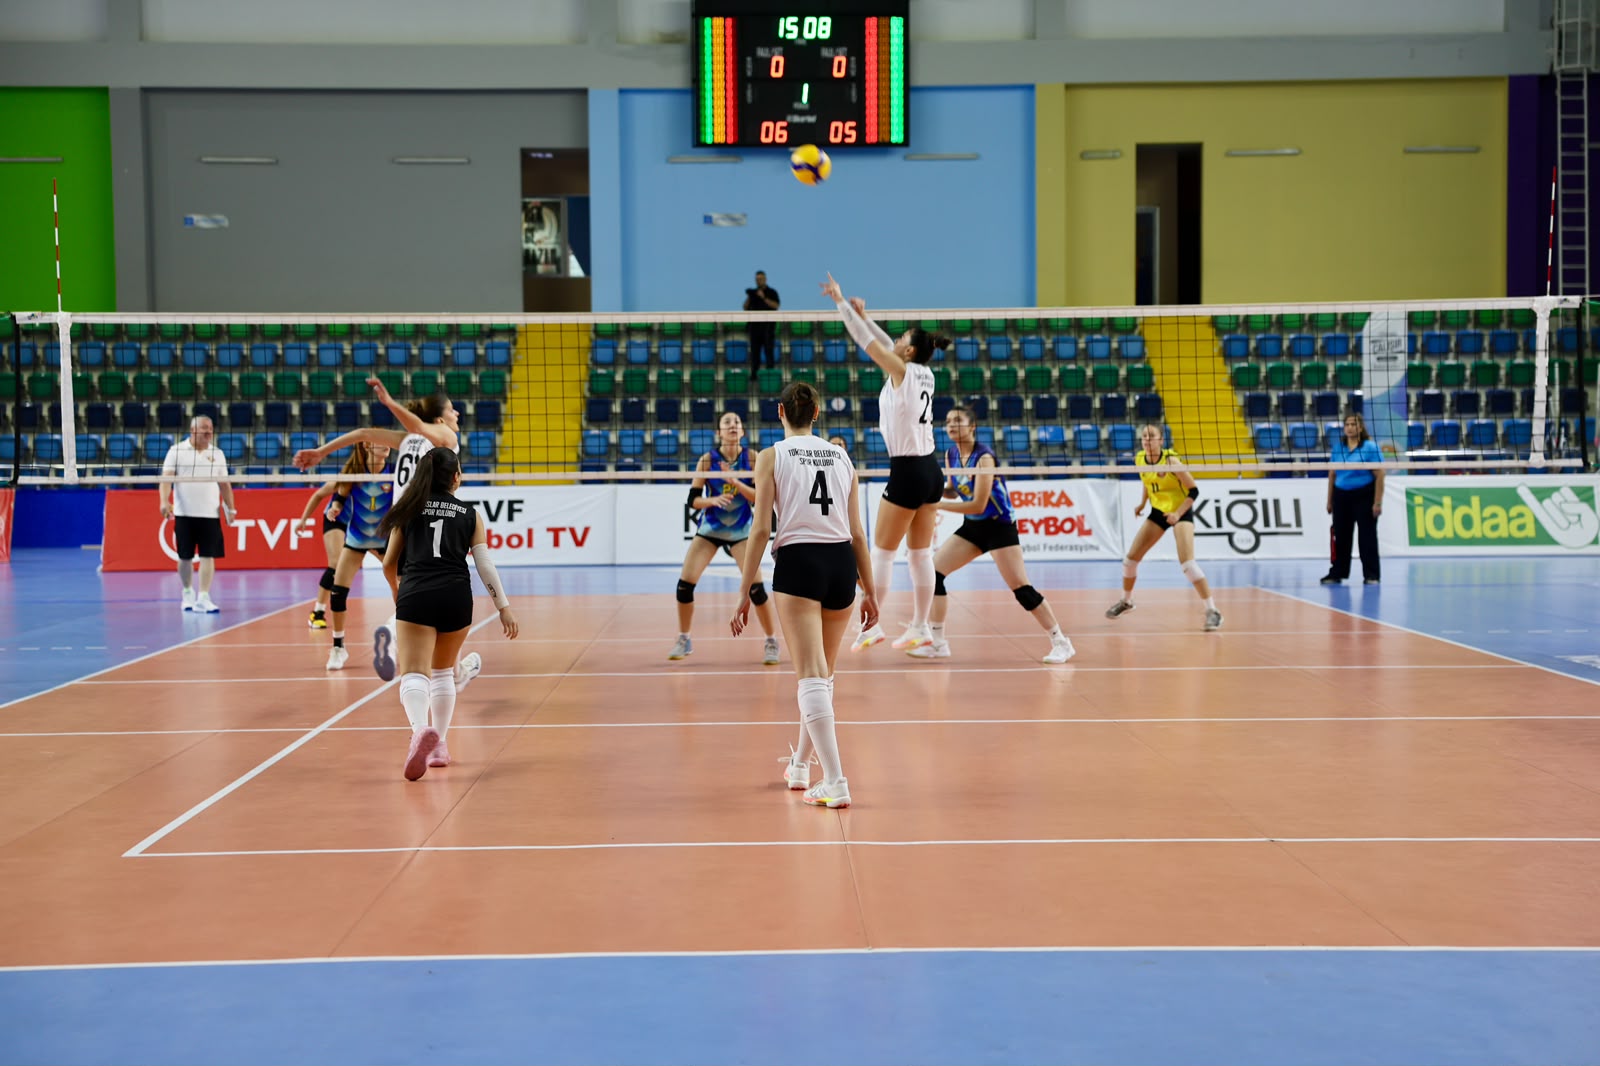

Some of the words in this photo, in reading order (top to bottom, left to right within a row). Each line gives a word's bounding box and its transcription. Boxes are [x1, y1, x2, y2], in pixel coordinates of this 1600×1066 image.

[770, 55, 784, 78] 0
[832, 55, 847, 78] 0
[802, 83, 809, 104] 1
[760, 121, 788, 143] 06
[829, 121, 857, 143] 05
[919, 390, 933, 424] 2
[397, 453, 420, 486] 6
[809, 470, 833, 516] 4
[1151, 482, 1159, 494] 11
[1017, 514, 1092, 537] EYBOL
[1414, 495, 1536, 540] iddaa
[230, 518, 316, 551] TVF
[429, 518, 444, 558] 1
[546, 526, 591, 548] TV
